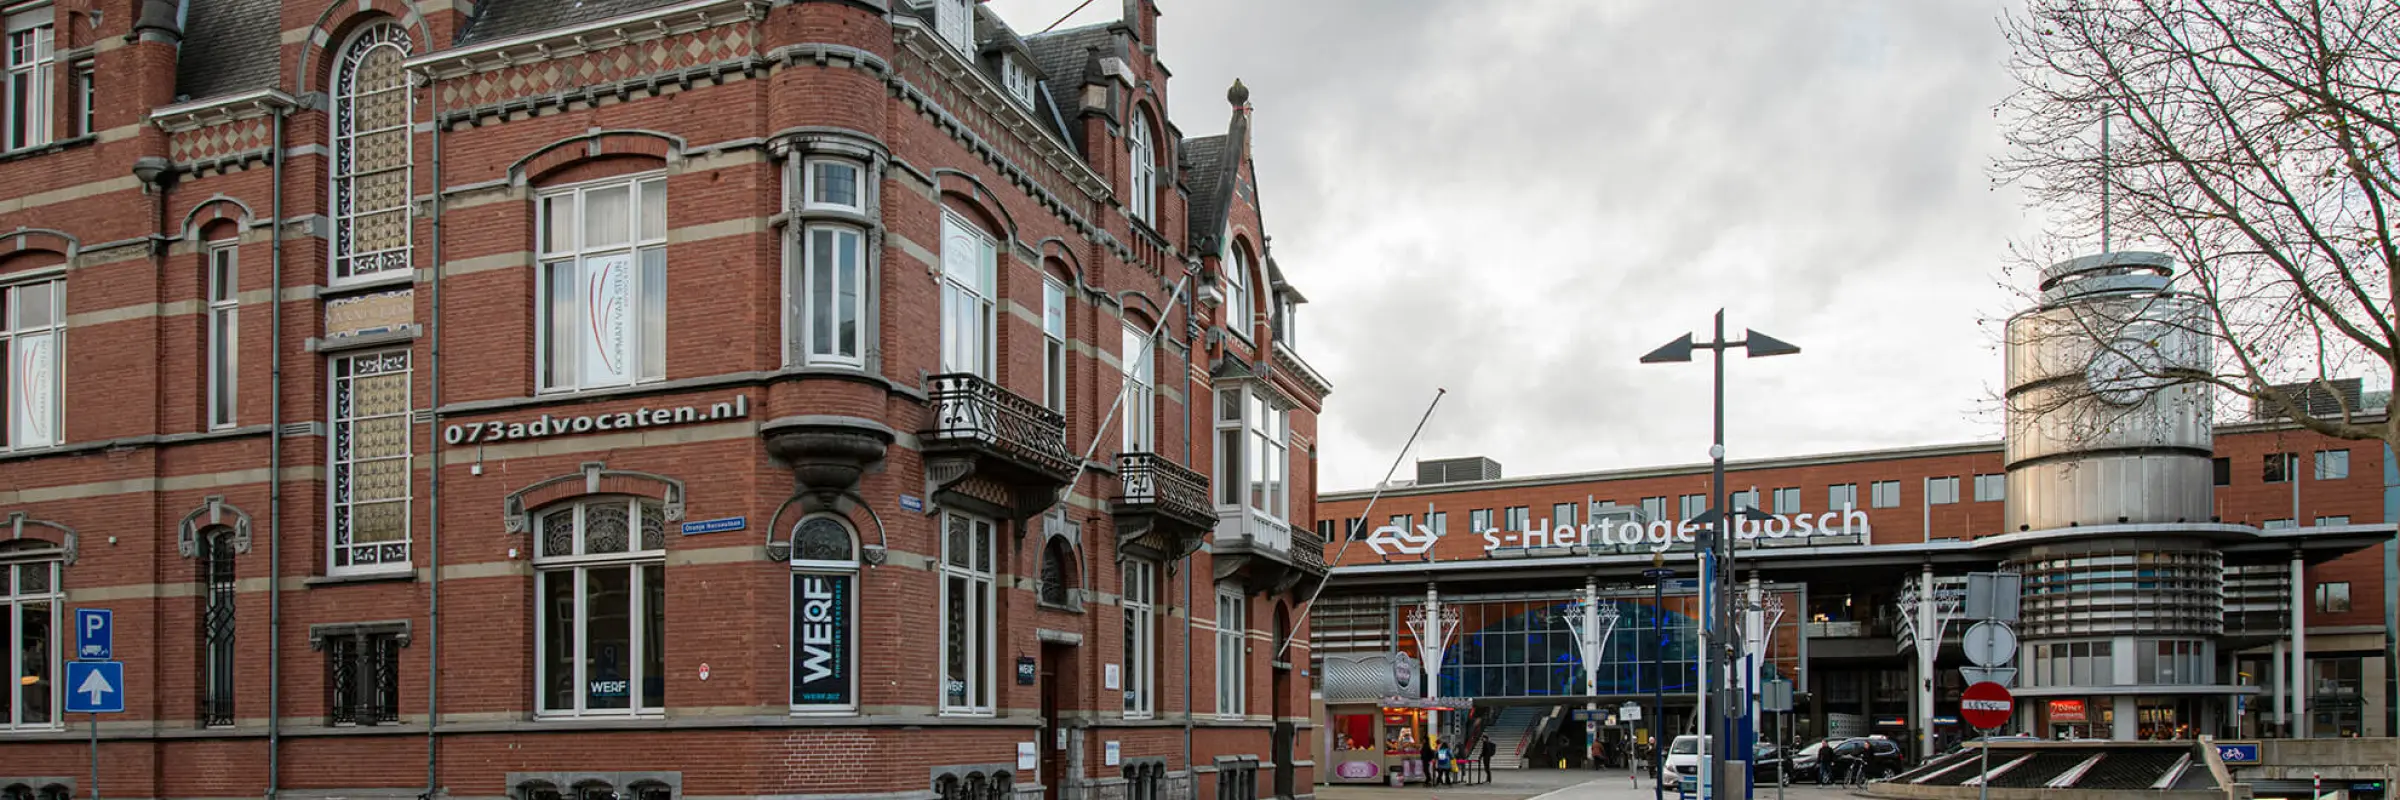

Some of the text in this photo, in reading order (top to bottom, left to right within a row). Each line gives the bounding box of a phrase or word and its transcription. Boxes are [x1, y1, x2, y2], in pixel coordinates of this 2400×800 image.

[614, 297, 623, 320] VAN
[444, 394, 747, 445] 073advocaten.nl
[685, 524, 705, 532] Oranje
[86, 613, 104, 639] P
[803, 578, 832, 684] WERF
[591, 681, 626, 693] WERF
